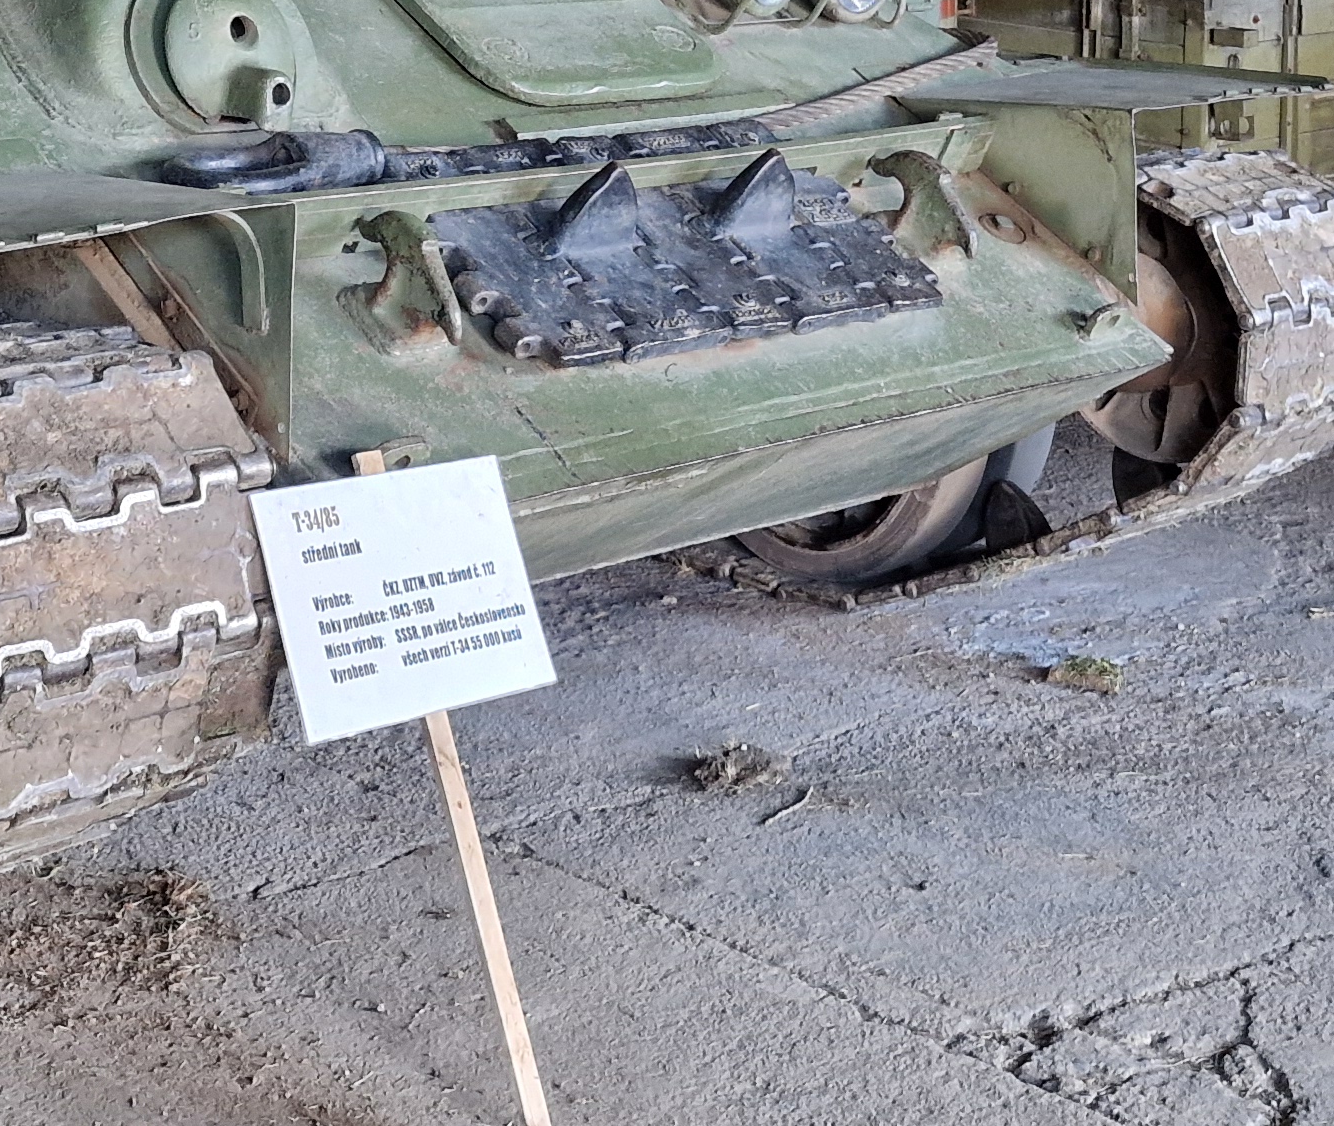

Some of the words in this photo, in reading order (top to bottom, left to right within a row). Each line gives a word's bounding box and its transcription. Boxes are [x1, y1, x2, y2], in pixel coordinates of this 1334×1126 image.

[291, 505, 340, 533] T-34/85
[301, 541, 339, 564] střední
[339, 538, 363, 557] tank
[312, 593, 354, 612] Výrobce:
[447, 565, 473, 584] závod
[473, 563, 482, 578] č.
[481, 560, 496, 576] 112
[318, 618, 342, 636] Roky
[343, 610, 389, 632] produkce:
[389, 597, 435, 621] 1943-1958
[324, 642, 352, 659] Místo
[352, 635, 386, 654] výroby:
[395, 625, 422, 643] SSSR,
[421, 625, 433, 639] po
[433, 618, 458, 635] válce
[458, 602, 526, 629] Československo
[330, 662, 379, 684] Vyrobeno:
[401, 647, 429, 667] všech
[429, 641, 451, 660] verzí
[450, 637, 471, 655] T-34
[470, 634, 483, 651] 55
[483, 630, 501, 648] 000
[501, 624, 522, 644] kusů
